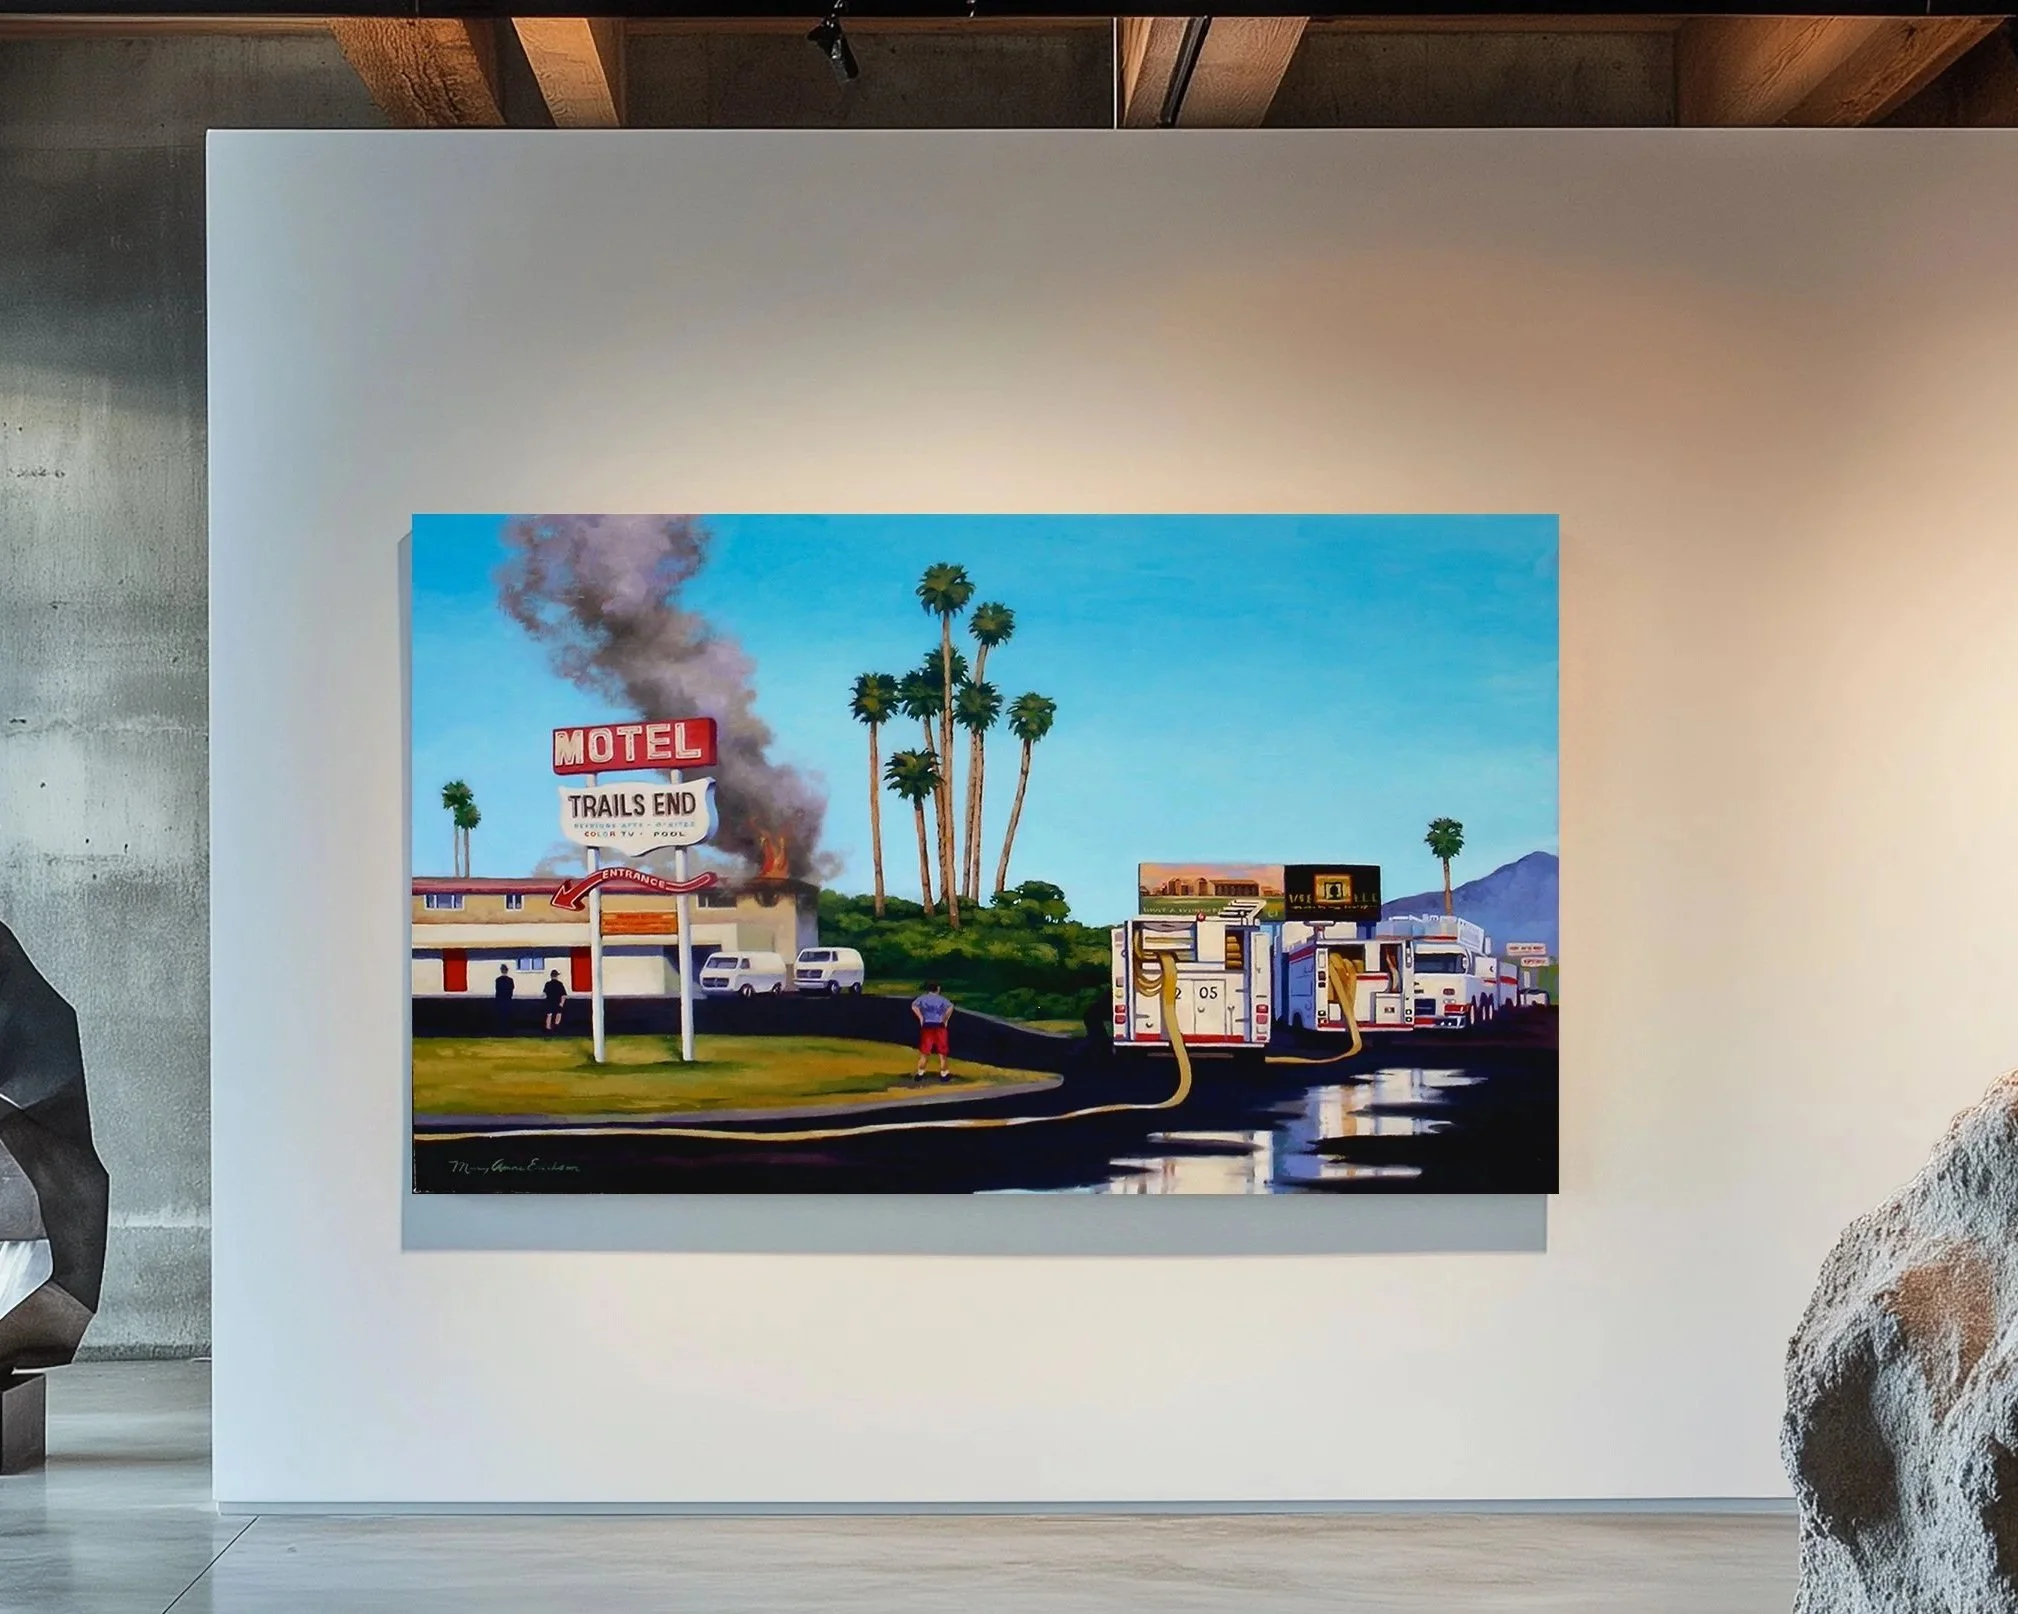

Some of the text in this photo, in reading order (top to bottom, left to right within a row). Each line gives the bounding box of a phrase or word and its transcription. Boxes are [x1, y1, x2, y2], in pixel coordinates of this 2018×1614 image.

[554, 722, 702, 766] MOTEL
[568, 791, 697, 819] TRAILS END
[602, 868, 667, 889] ENTRANCE
[1199, 986, 1218, 1000] 05
